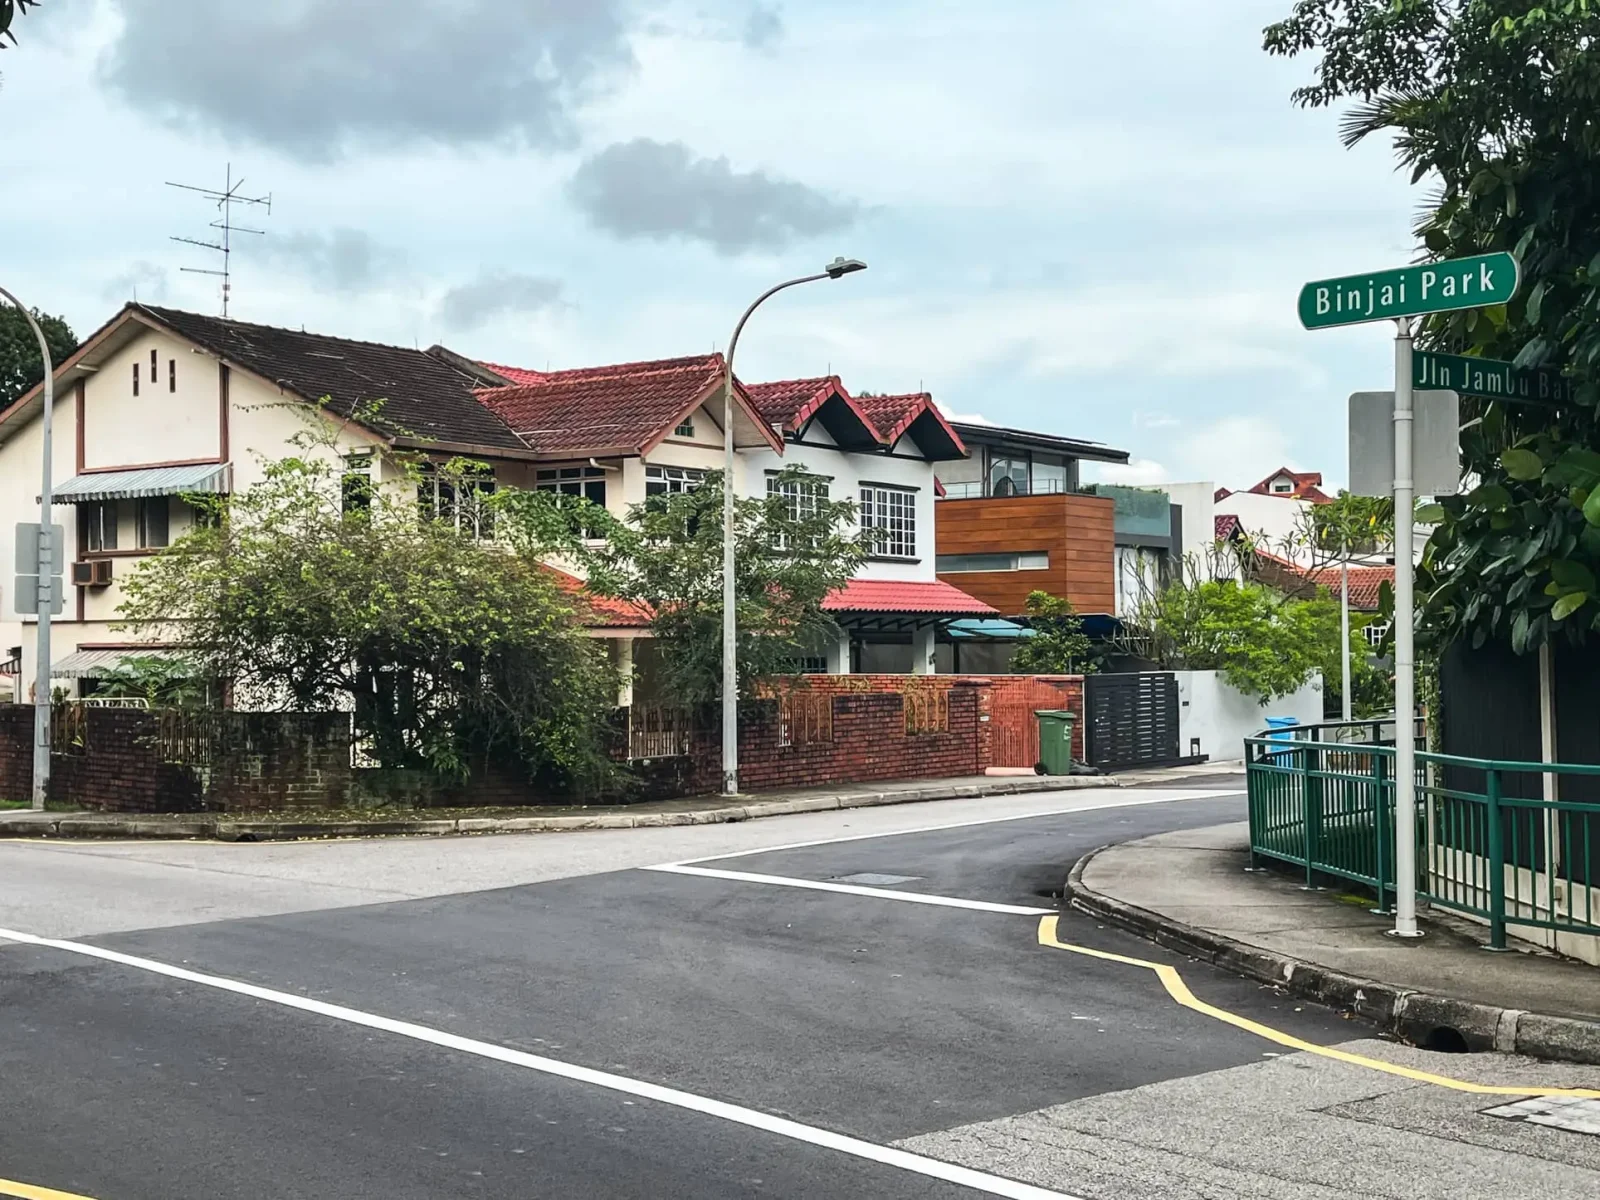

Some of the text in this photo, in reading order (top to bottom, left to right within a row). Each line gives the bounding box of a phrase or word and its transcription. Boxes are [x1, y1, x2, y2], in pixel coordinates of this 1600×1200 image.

[1316, 263, 1495, 316] Binjai Park
[1419, 356, 1573, 400] Jln Jambu Bat
